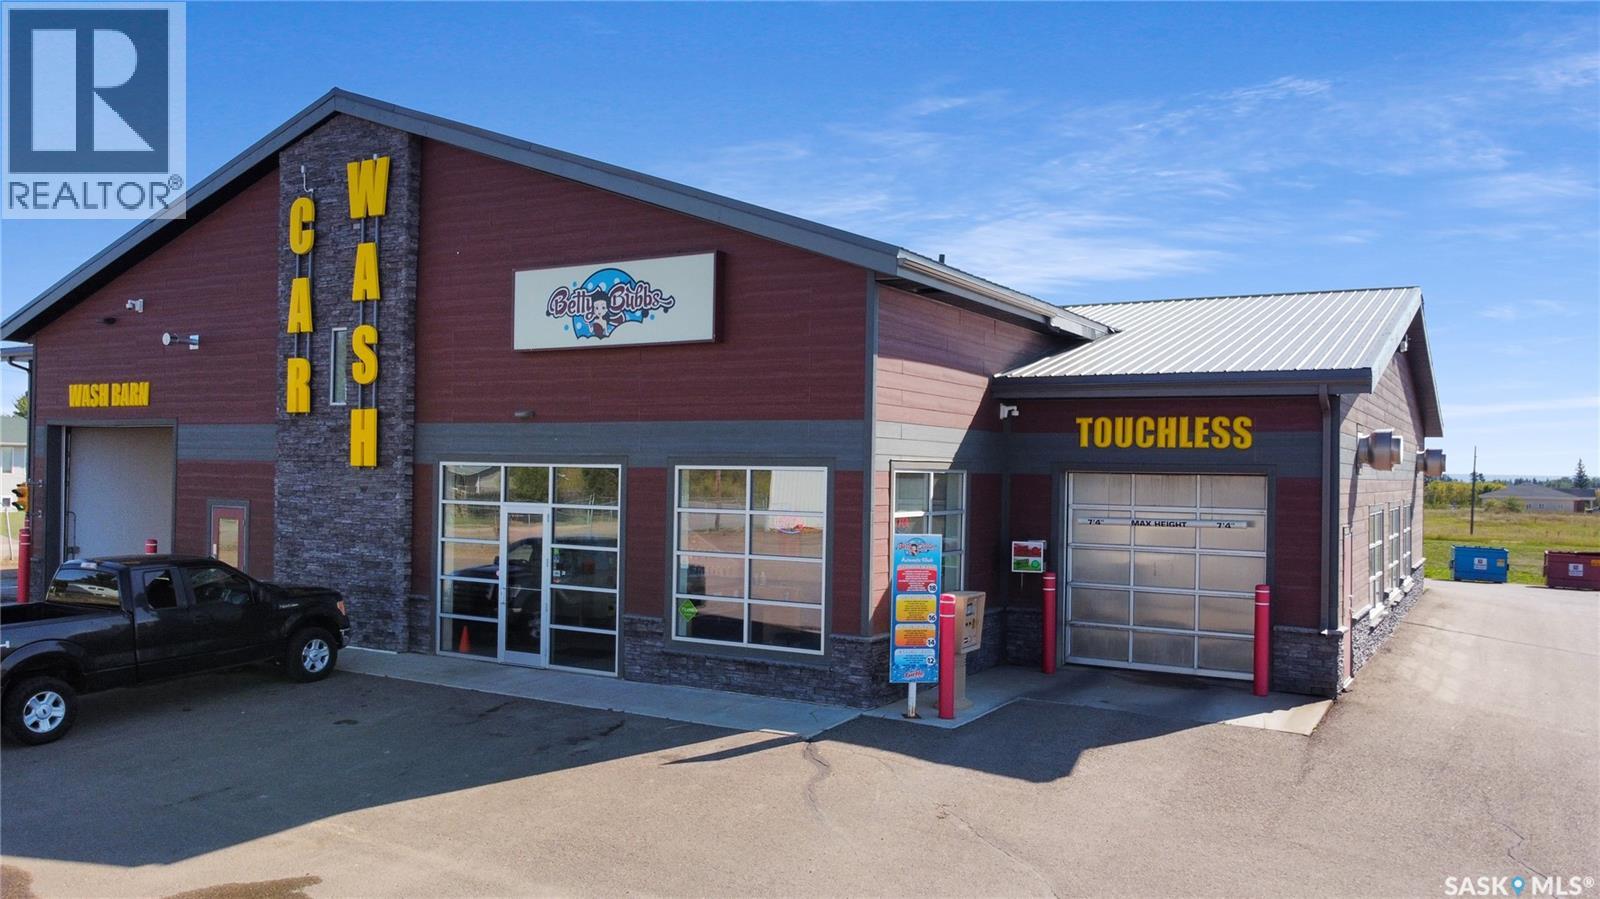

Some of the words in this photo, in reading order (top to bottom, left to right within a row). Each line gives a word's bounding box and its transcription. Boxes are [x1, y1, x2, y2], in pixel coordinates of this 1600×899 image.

[286, 197, 315, 415] CAR
[347, 156, 390, 468] WASH
[548, 286, 597, 322] Betty
[607, 281, 676, 313] Bubbs
[69, 383, 109, 408] WASH
[111, 381, 150, 407] BARN
[1076, 416, 1253, 449] TOUCHLESS
[1131, 519, 1152, 528] MAX
[1154, 520, 1187, 529] HEIGHT
[927, 638, 936, 646] 14
[926, 657, 935, 665] 12
